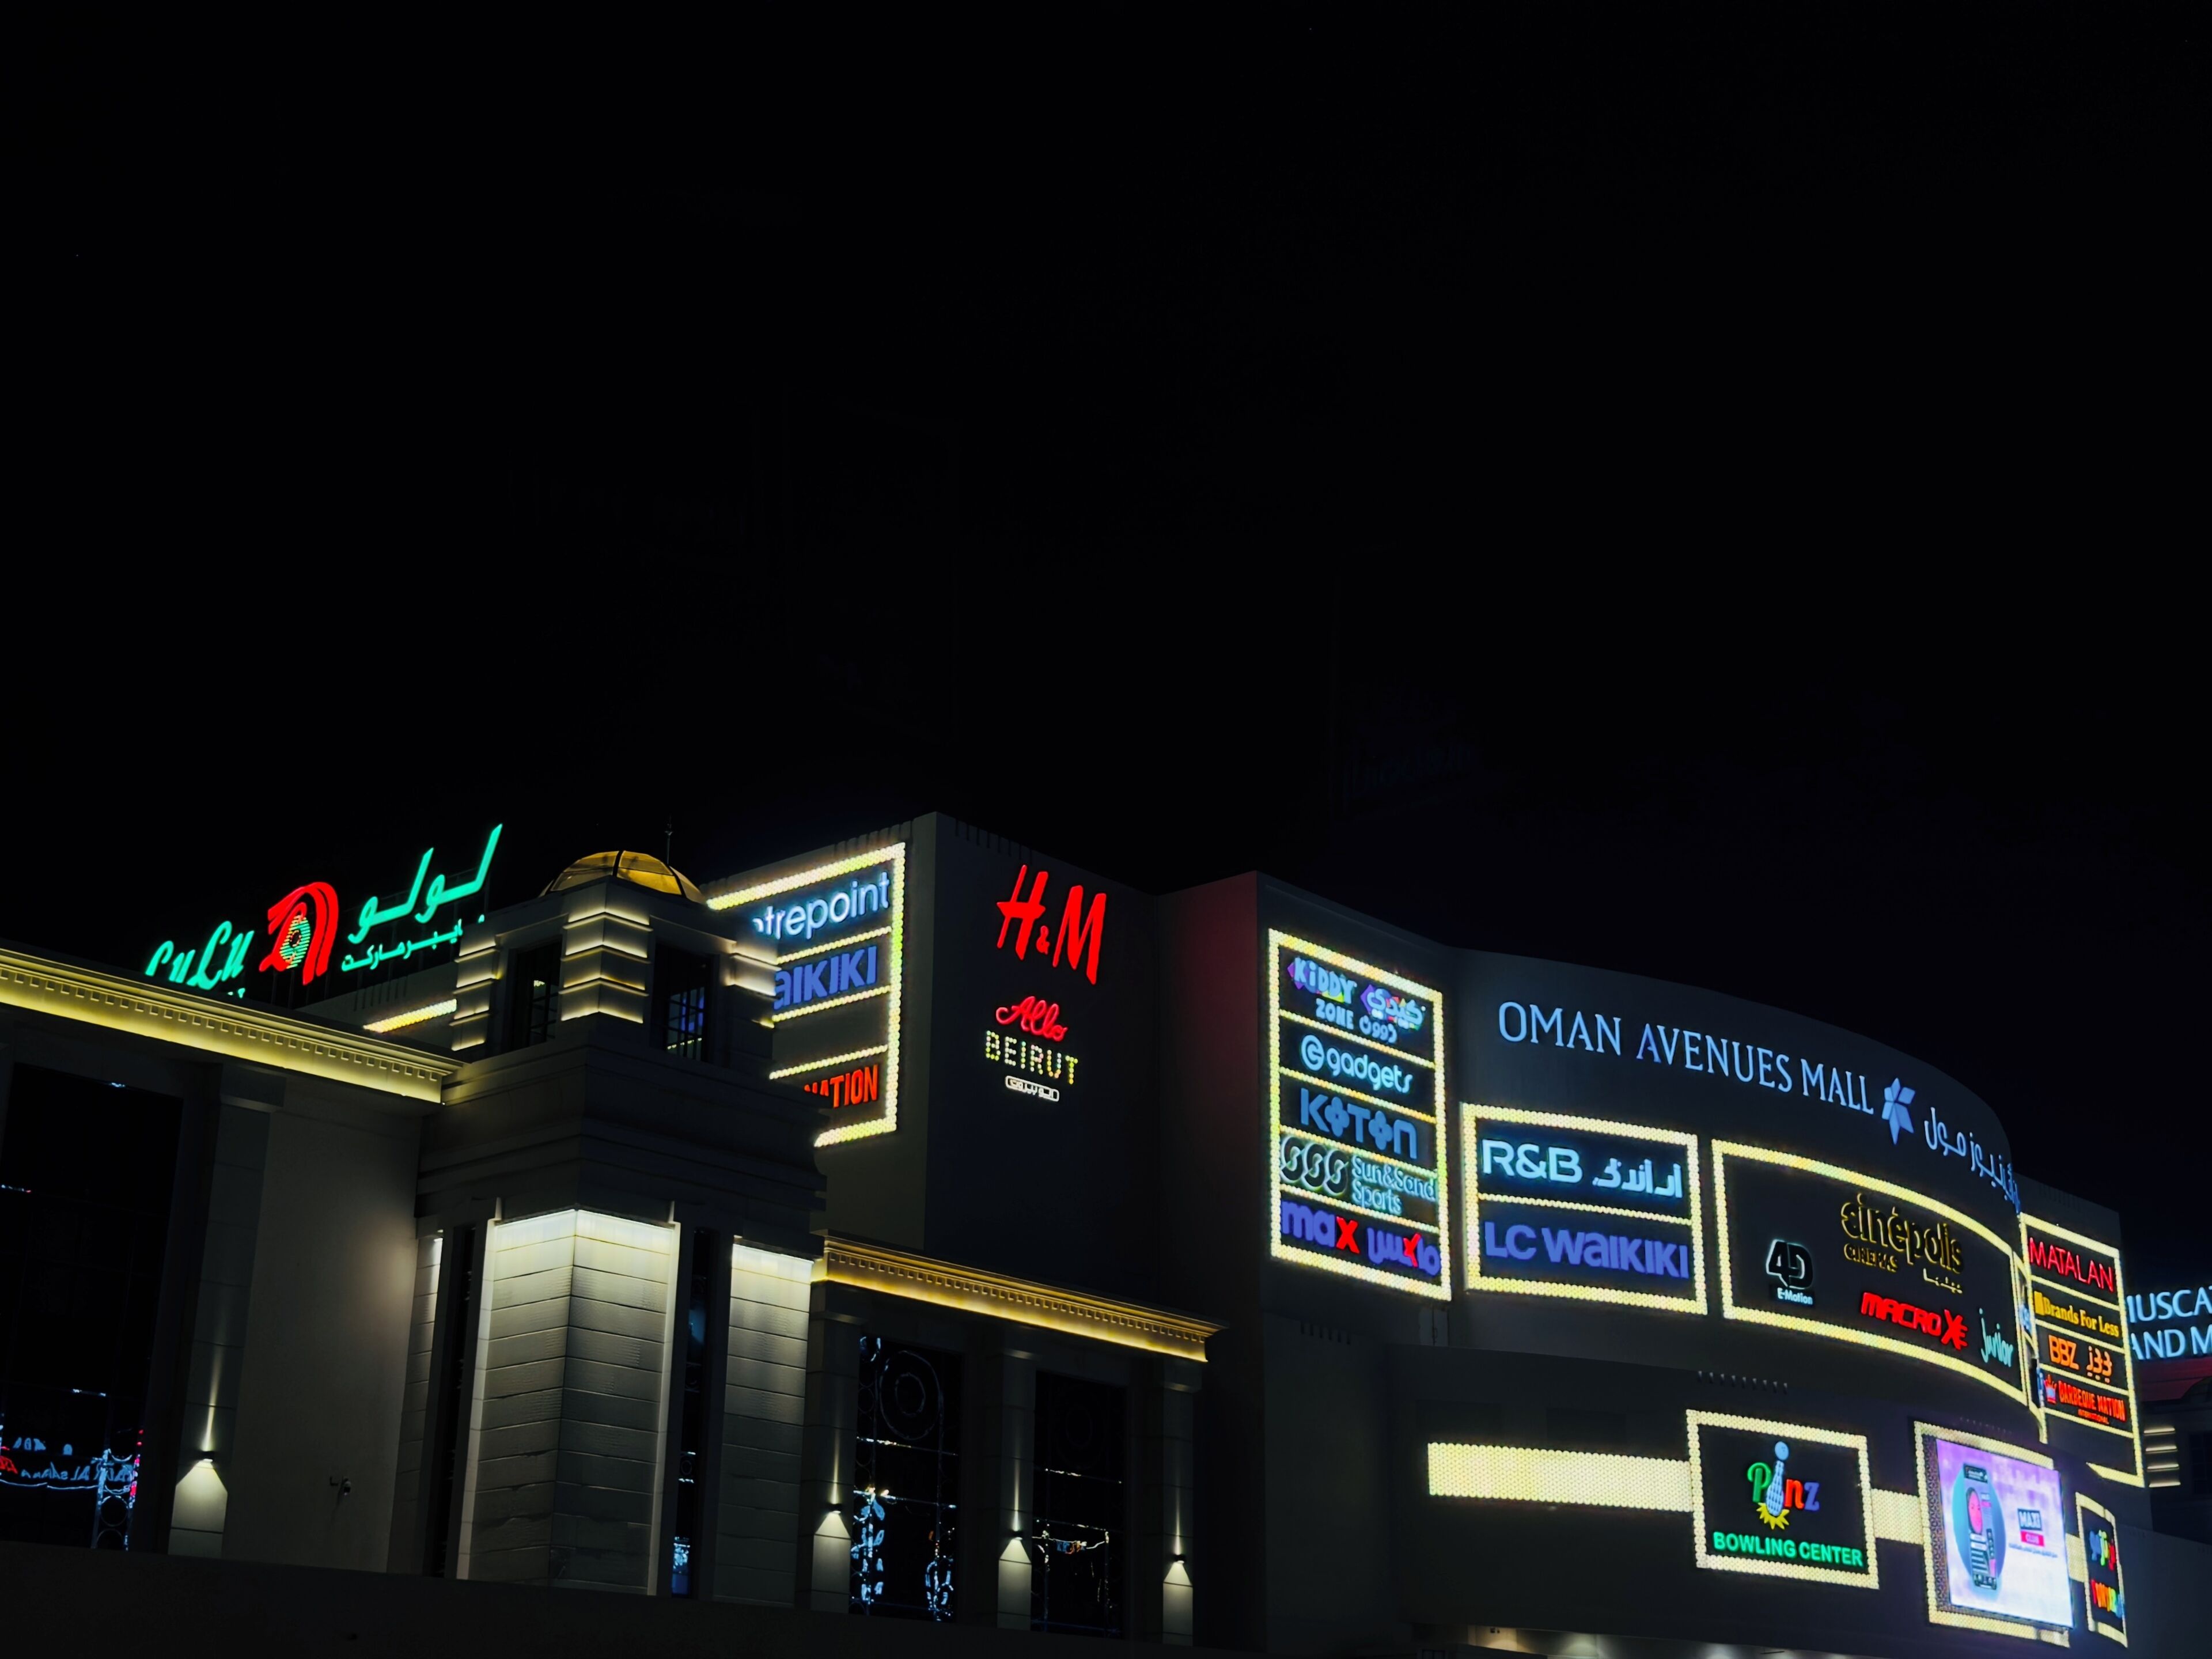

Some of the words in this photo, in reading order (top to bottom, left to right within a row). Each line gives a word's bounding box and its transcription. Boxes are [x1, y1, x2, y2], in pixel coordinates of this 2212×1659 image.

[348, 824, 502, 944] لولو
[996, 864, 1107, 985] H&M
[995, 995, 1069, 1042] Allo
[1316, 998, 1354, 1030] ZONE
[986, 1030, 1079, 1085] BEIRUT
[1327, 1047, 1413, 1093] gadgets
[1499, 1001, 1622, 1056] OMAN
[1636, 1023, 1793, 1092] AVENUES
[1801, 1058, 1874, 1115] MALL
[1482, 1139, 1583, 1184] R&B
[1351, 1181, 1402, 1216] Sports
[1281, 1200, 1360, 1253] max
[1484, 1221, 1537, 1260] LC
[2029, 1237, 2114, 1293] MATALAN
[1777, 1287, 1813, 1305] E-Motion
[2042, 1296, 2080, 1325] Brands
[2079, 1309, 2097, 1331] For
[2098, 1315, 2119, 1338] Less
[2126, 1285, 2212, 1323] USCA
[2048, 1335, 2080, 1370] BBZ
[1713, 1531, 1797, 1559] BOWLING
[1798, 1541, 1864, 1568] CENTER
